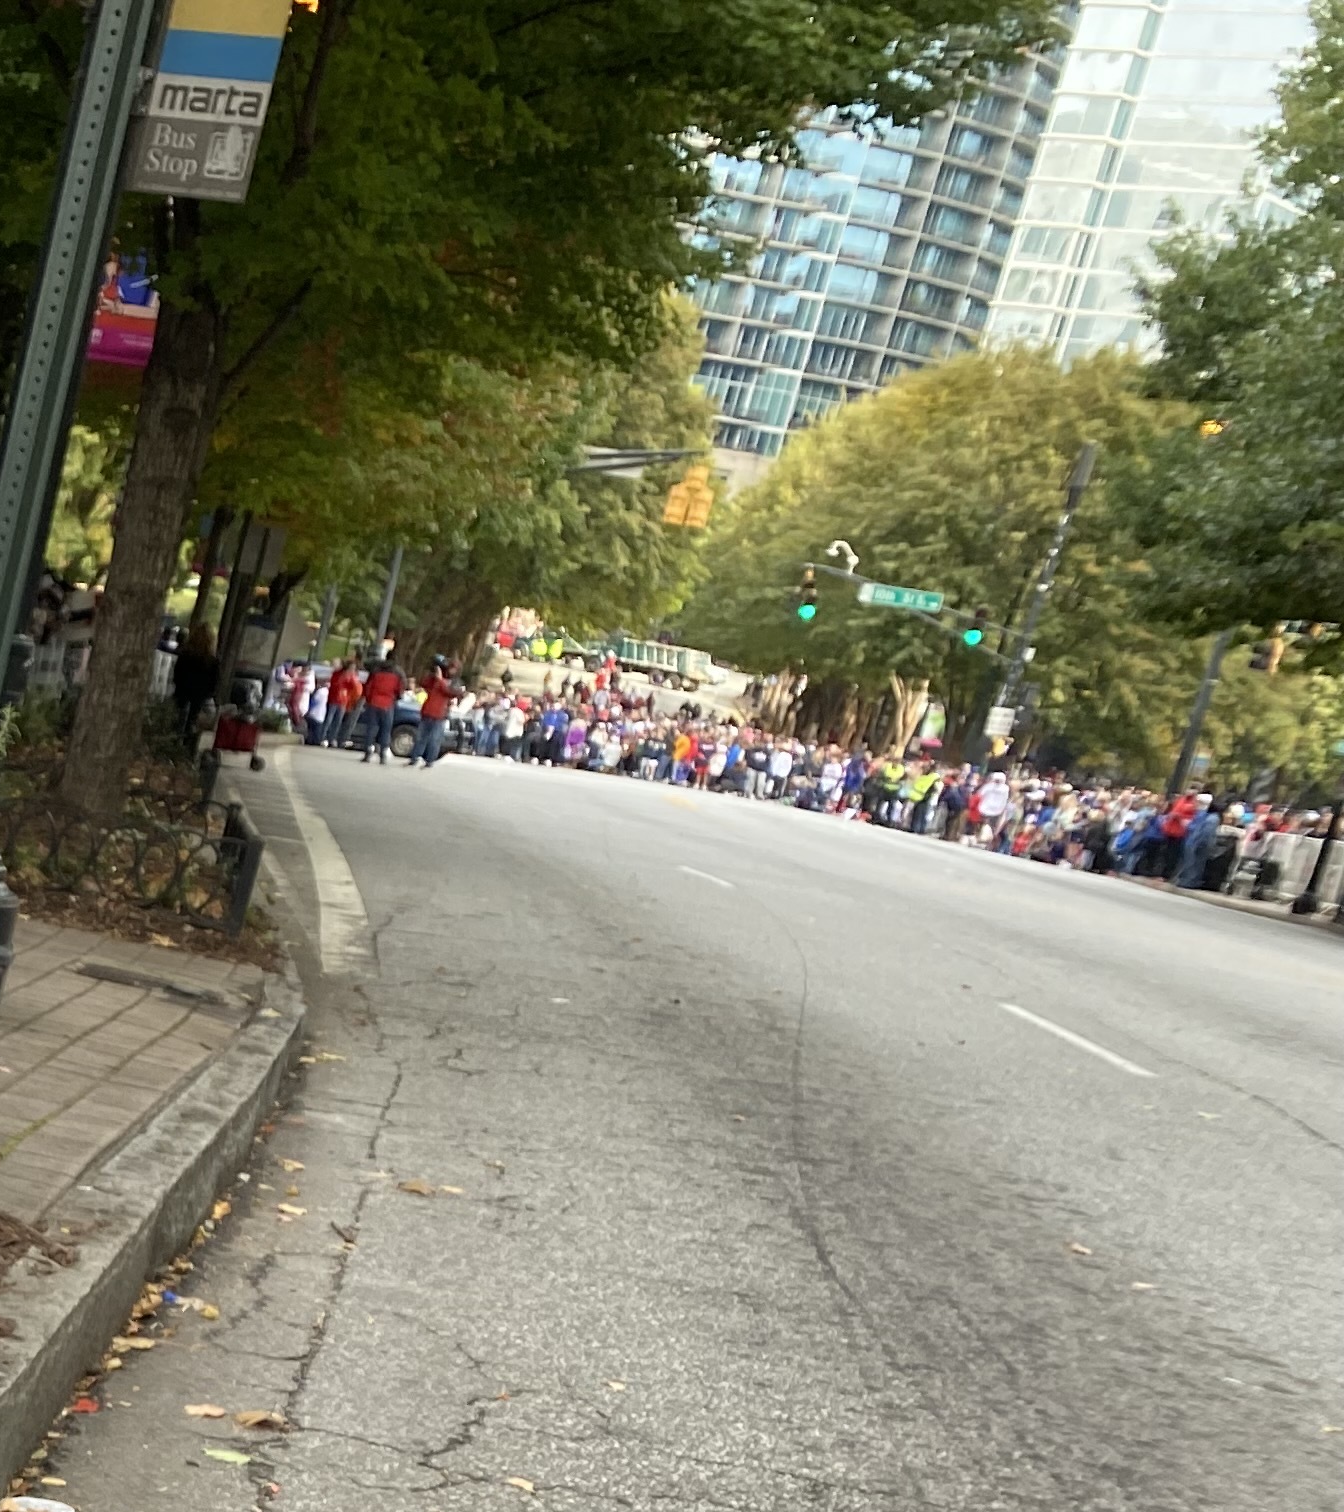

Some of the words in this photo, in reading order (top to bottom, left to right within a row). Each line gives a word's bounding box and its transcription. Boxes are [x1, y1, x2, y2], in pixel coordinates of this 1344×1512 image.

[160, 84, 263, 117] marta
[153, 123, 198, 149] Bus
[144, 147, 198, 182] Stop
